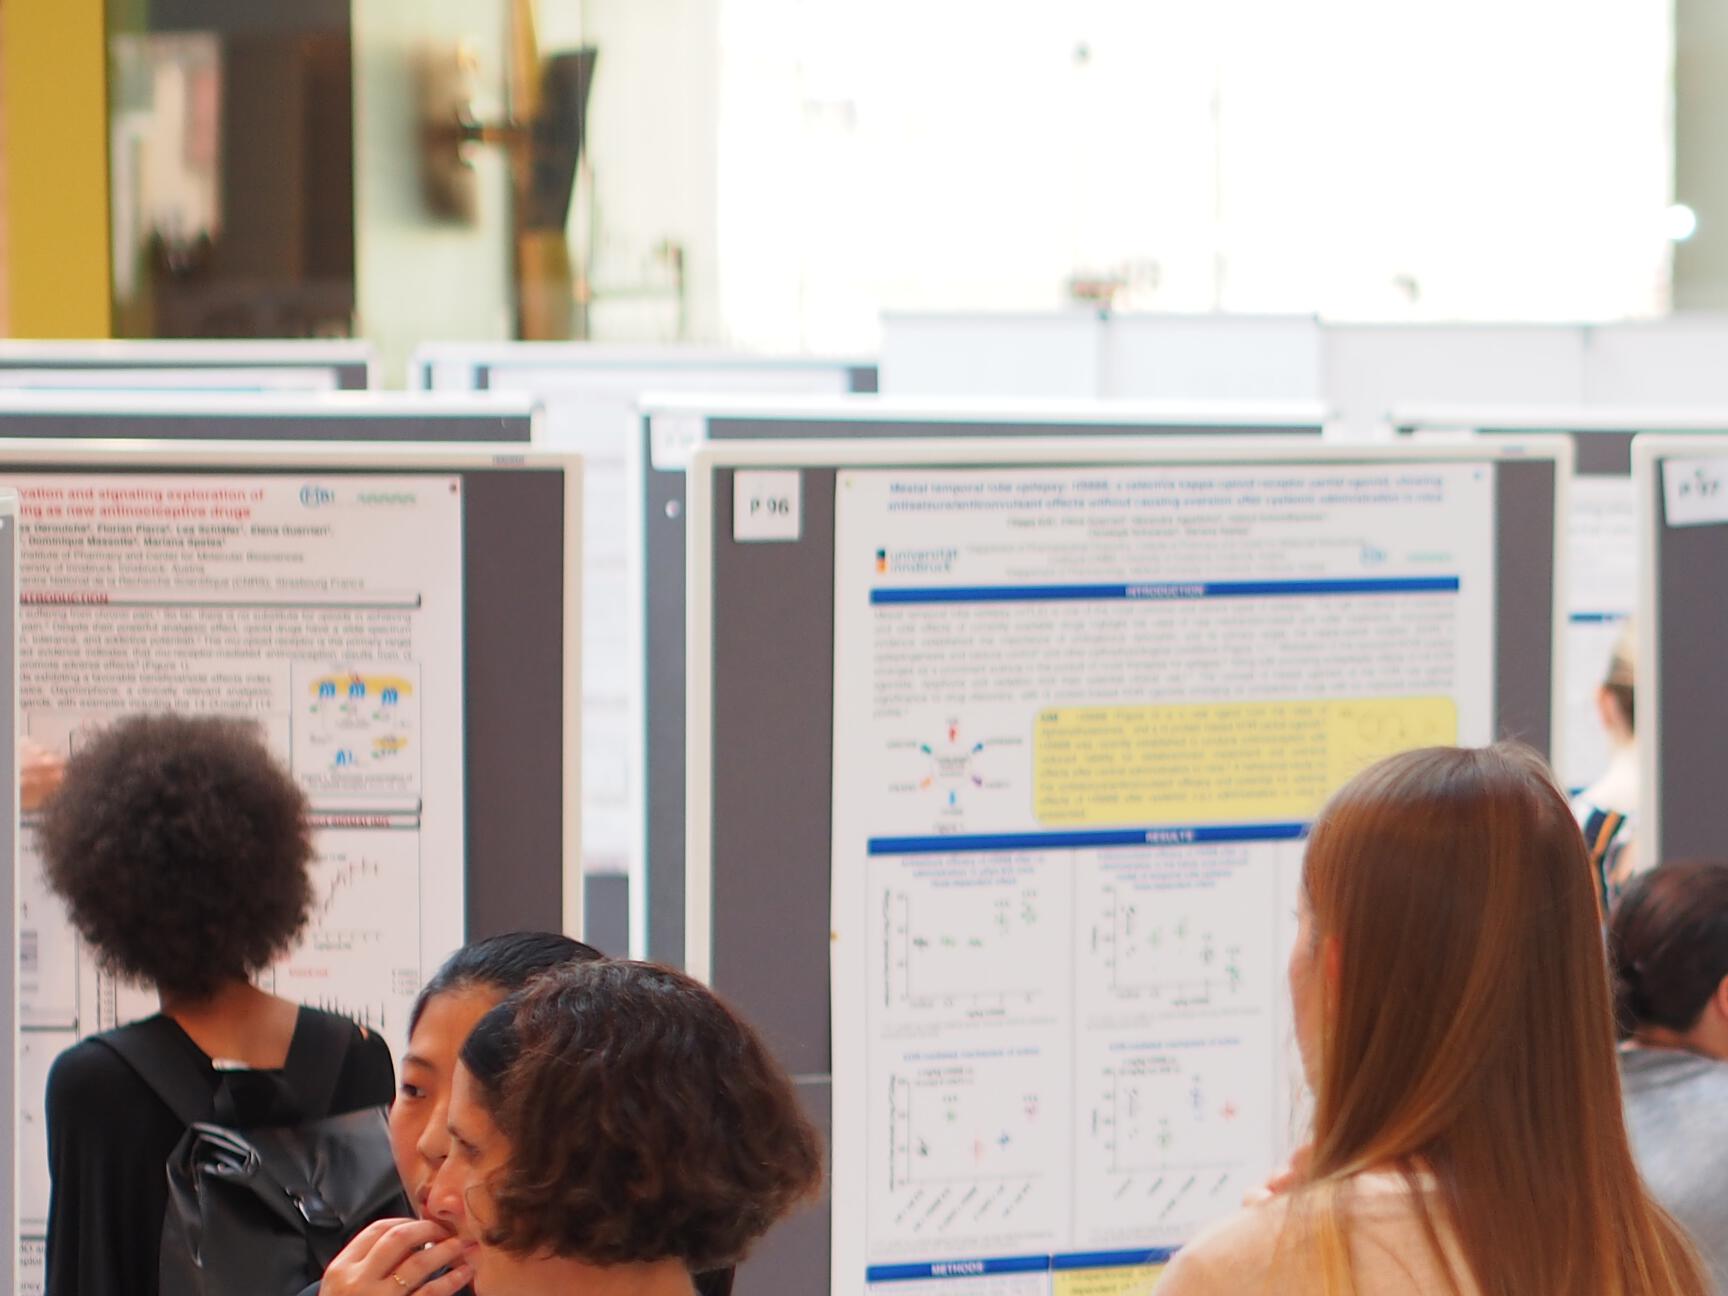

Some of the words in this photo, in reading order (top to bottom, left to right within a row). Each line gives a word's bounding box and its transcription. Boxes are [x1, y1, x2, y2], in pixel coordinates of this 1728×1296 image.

[69, 489, 94, 499] and
[100, 489, 162, 503] signaling
[168, 489, 246, 503] exploration
[251, 489, 264, 500] of
[20, 506, 42, 518] ing
[47, 507, 62, 516] as
[67, 507, 95, 516] new
[211, 506, 251, 519] drugs
[750, 497, 760, 517] P
[767, 496, 789, 516] 96
